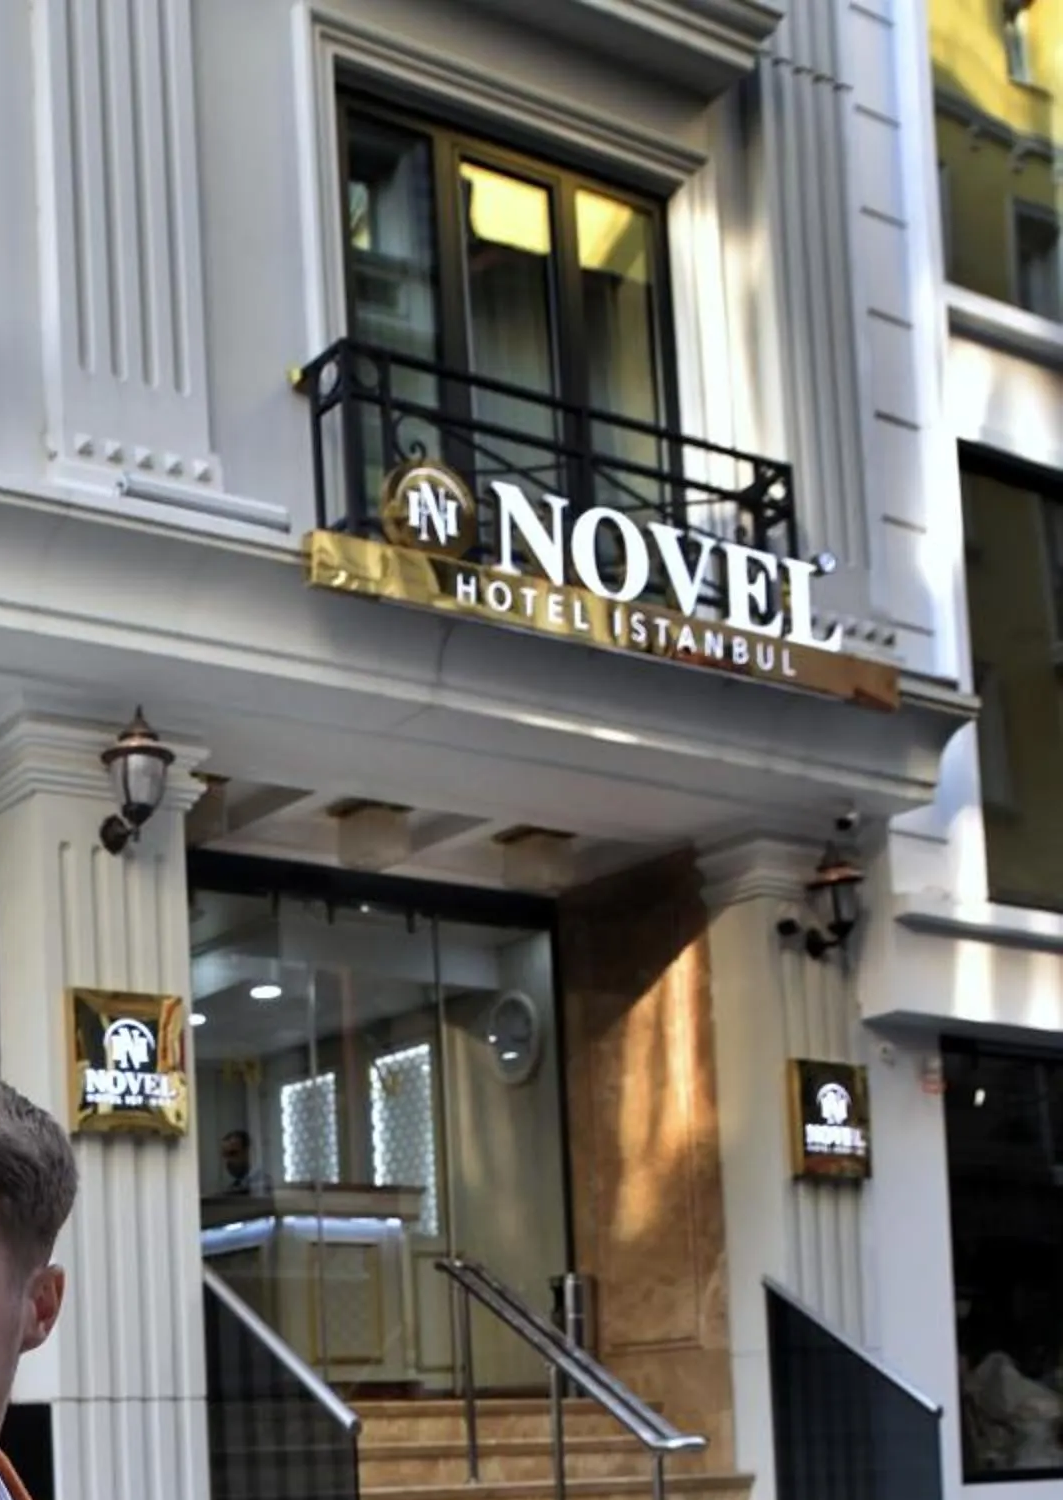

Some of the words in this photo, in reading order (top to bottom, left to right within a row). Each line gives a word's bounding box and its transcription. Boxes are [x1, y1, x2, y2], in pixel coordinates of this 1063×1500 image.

[490, 480, 843, 652] NOVEL
[456, 573, 590, 631] HOTEL
[85, 1069, 178, 1098] NOVEL
